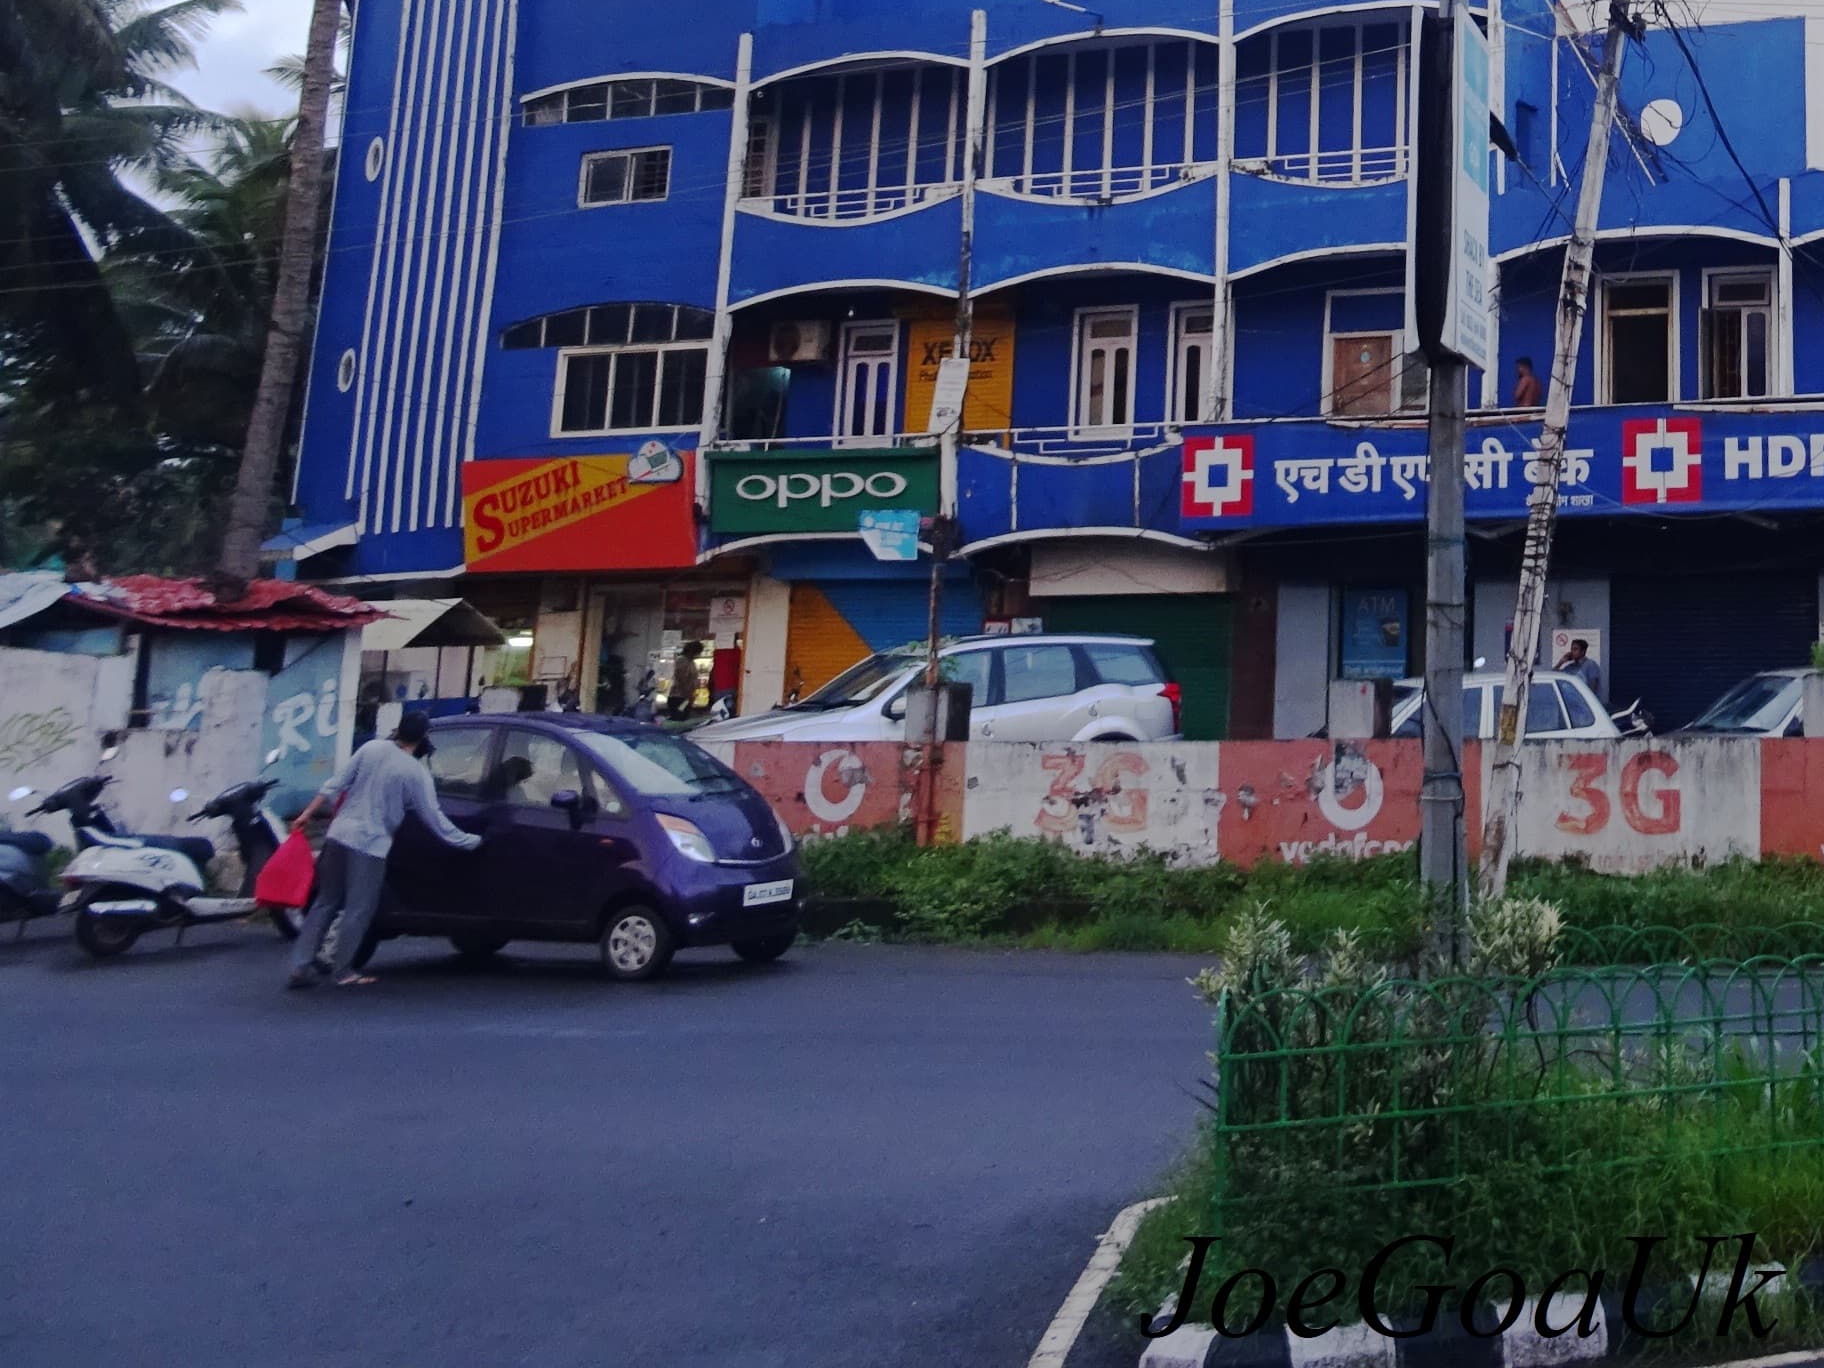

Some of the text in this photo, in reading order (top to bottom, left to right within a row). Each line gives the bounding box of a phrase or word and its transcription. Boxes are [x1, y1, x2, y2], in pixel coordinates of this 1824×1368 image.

[922, 338, 999, 366] XEOX
[473, 460, 582, 553] SUZUKI
[1273, 458, 1334, 504] एच
[1337, 441, 1387, 493] डी
[1033, 751, 1152, 834] 3G
[1554, 750, 1682, 834] 3G
